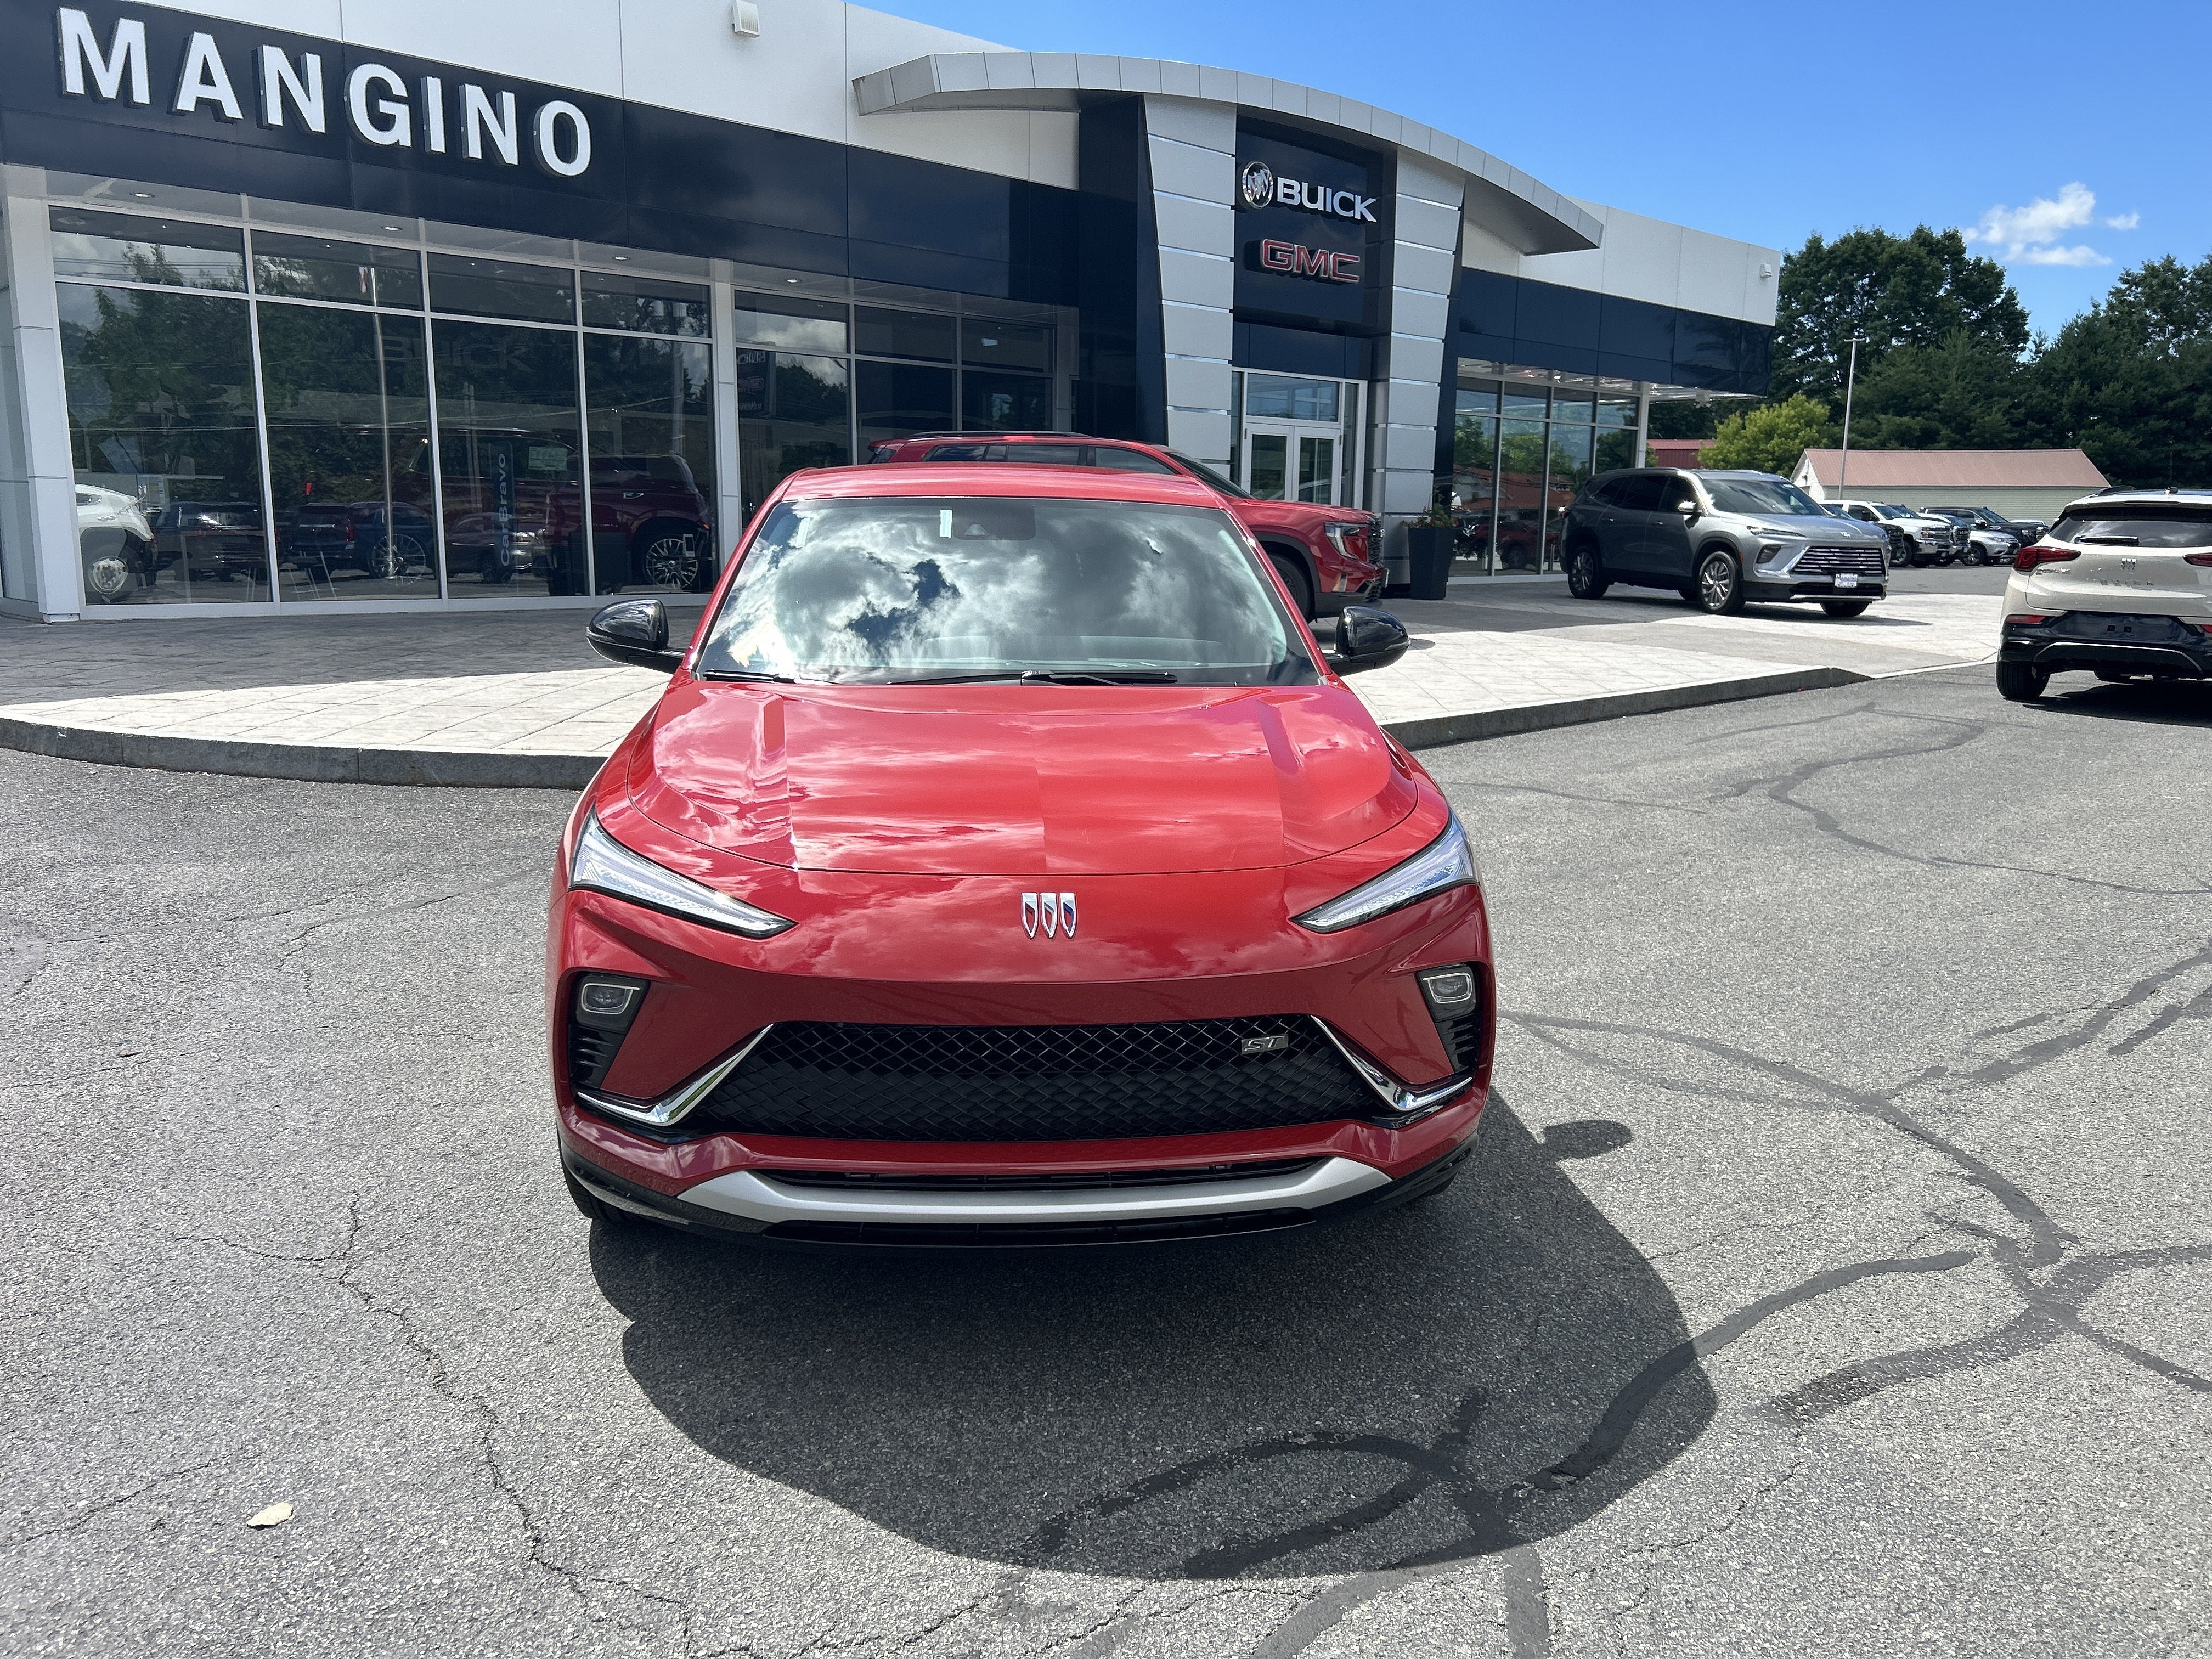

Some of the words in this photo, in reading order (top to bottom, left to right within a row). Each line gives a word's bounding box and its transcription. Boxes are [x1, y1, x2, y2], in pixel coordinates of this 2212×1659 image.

[56, 6, 592, 178] MANGINO
[1277, 177, 1377, 223] BUICK
[1261, 239, 1360, 284] GMC
[374, 334, 536, 372] BUICK
[499, 453, 510, 567] CarBravo
[1244, 1035, 1285, 1052] ST
